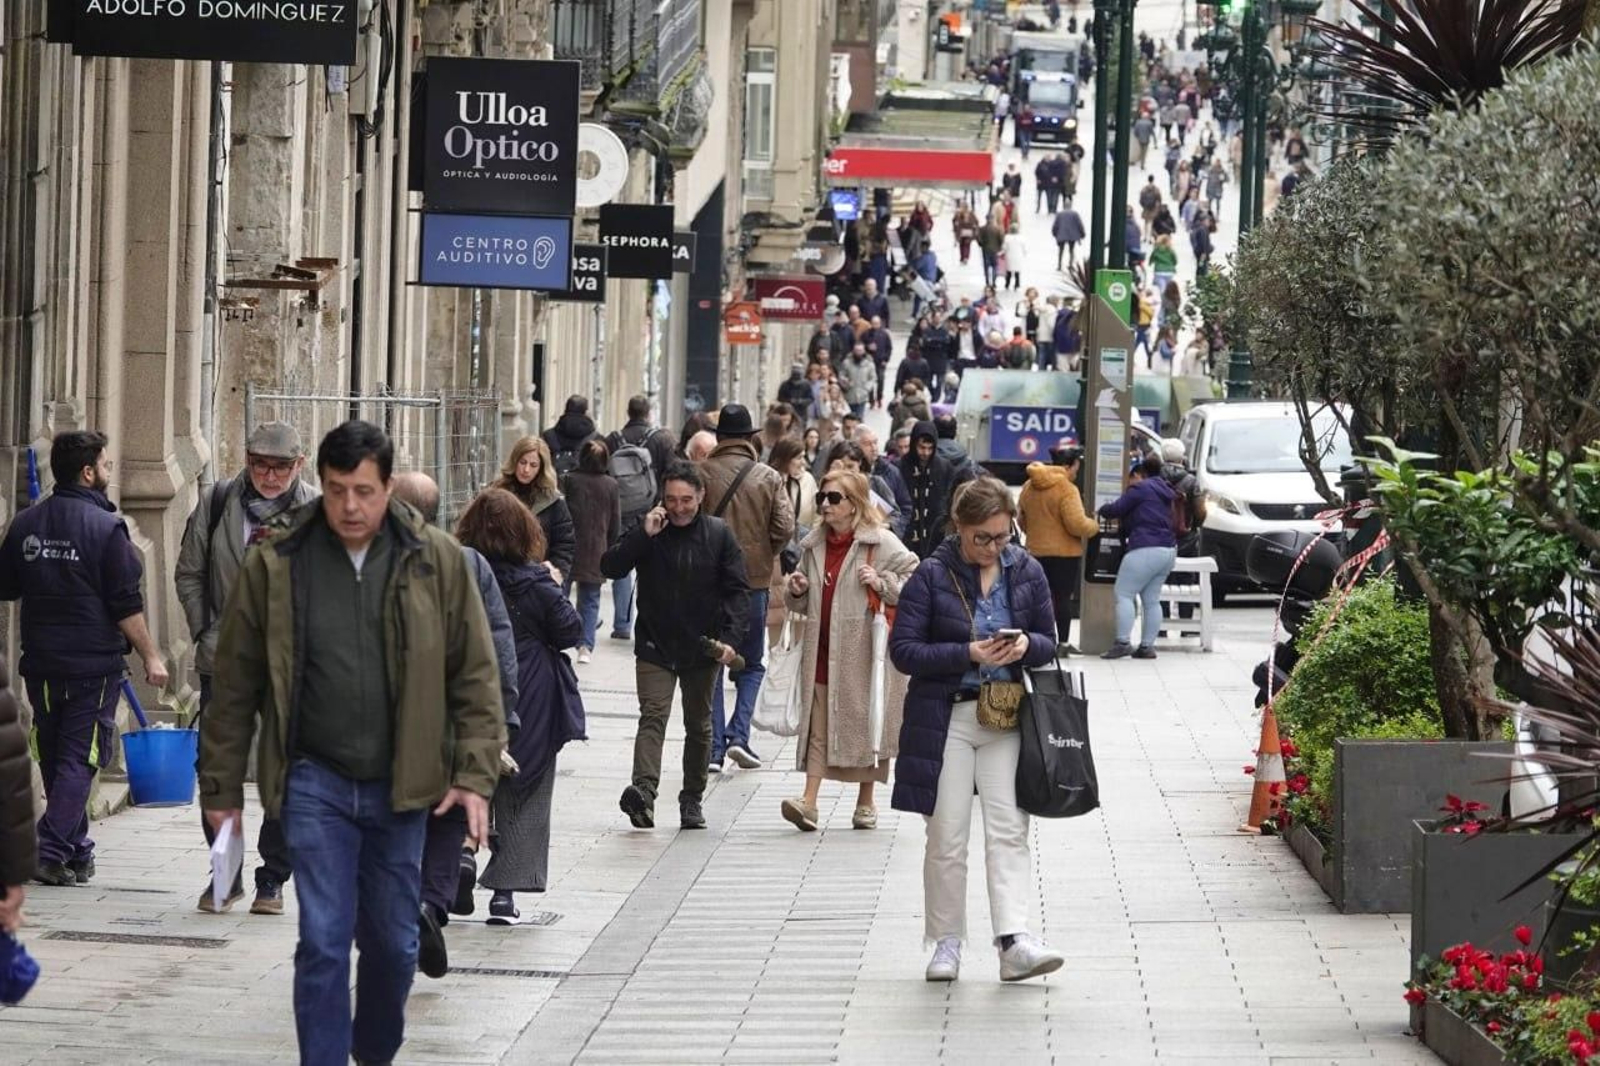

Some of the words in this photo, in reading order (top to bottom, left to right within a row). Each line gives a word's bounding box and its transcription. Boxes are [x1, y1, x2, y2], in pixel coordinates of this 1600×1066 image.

[86, 0, 186, 17] ADOLFO
[199, 0, 345, 22] DOMINGUEZ
[456, 91, 549, 126] Ulloa
[444, 125, 559, 169] Optico
[452, 236, 528, 251] CENTRO
[602, 235, 670, 248] SEPHORA
[436, 250, 527, 265] AUDITIVO
[1006, 408, 1076, 433] SAÍD
